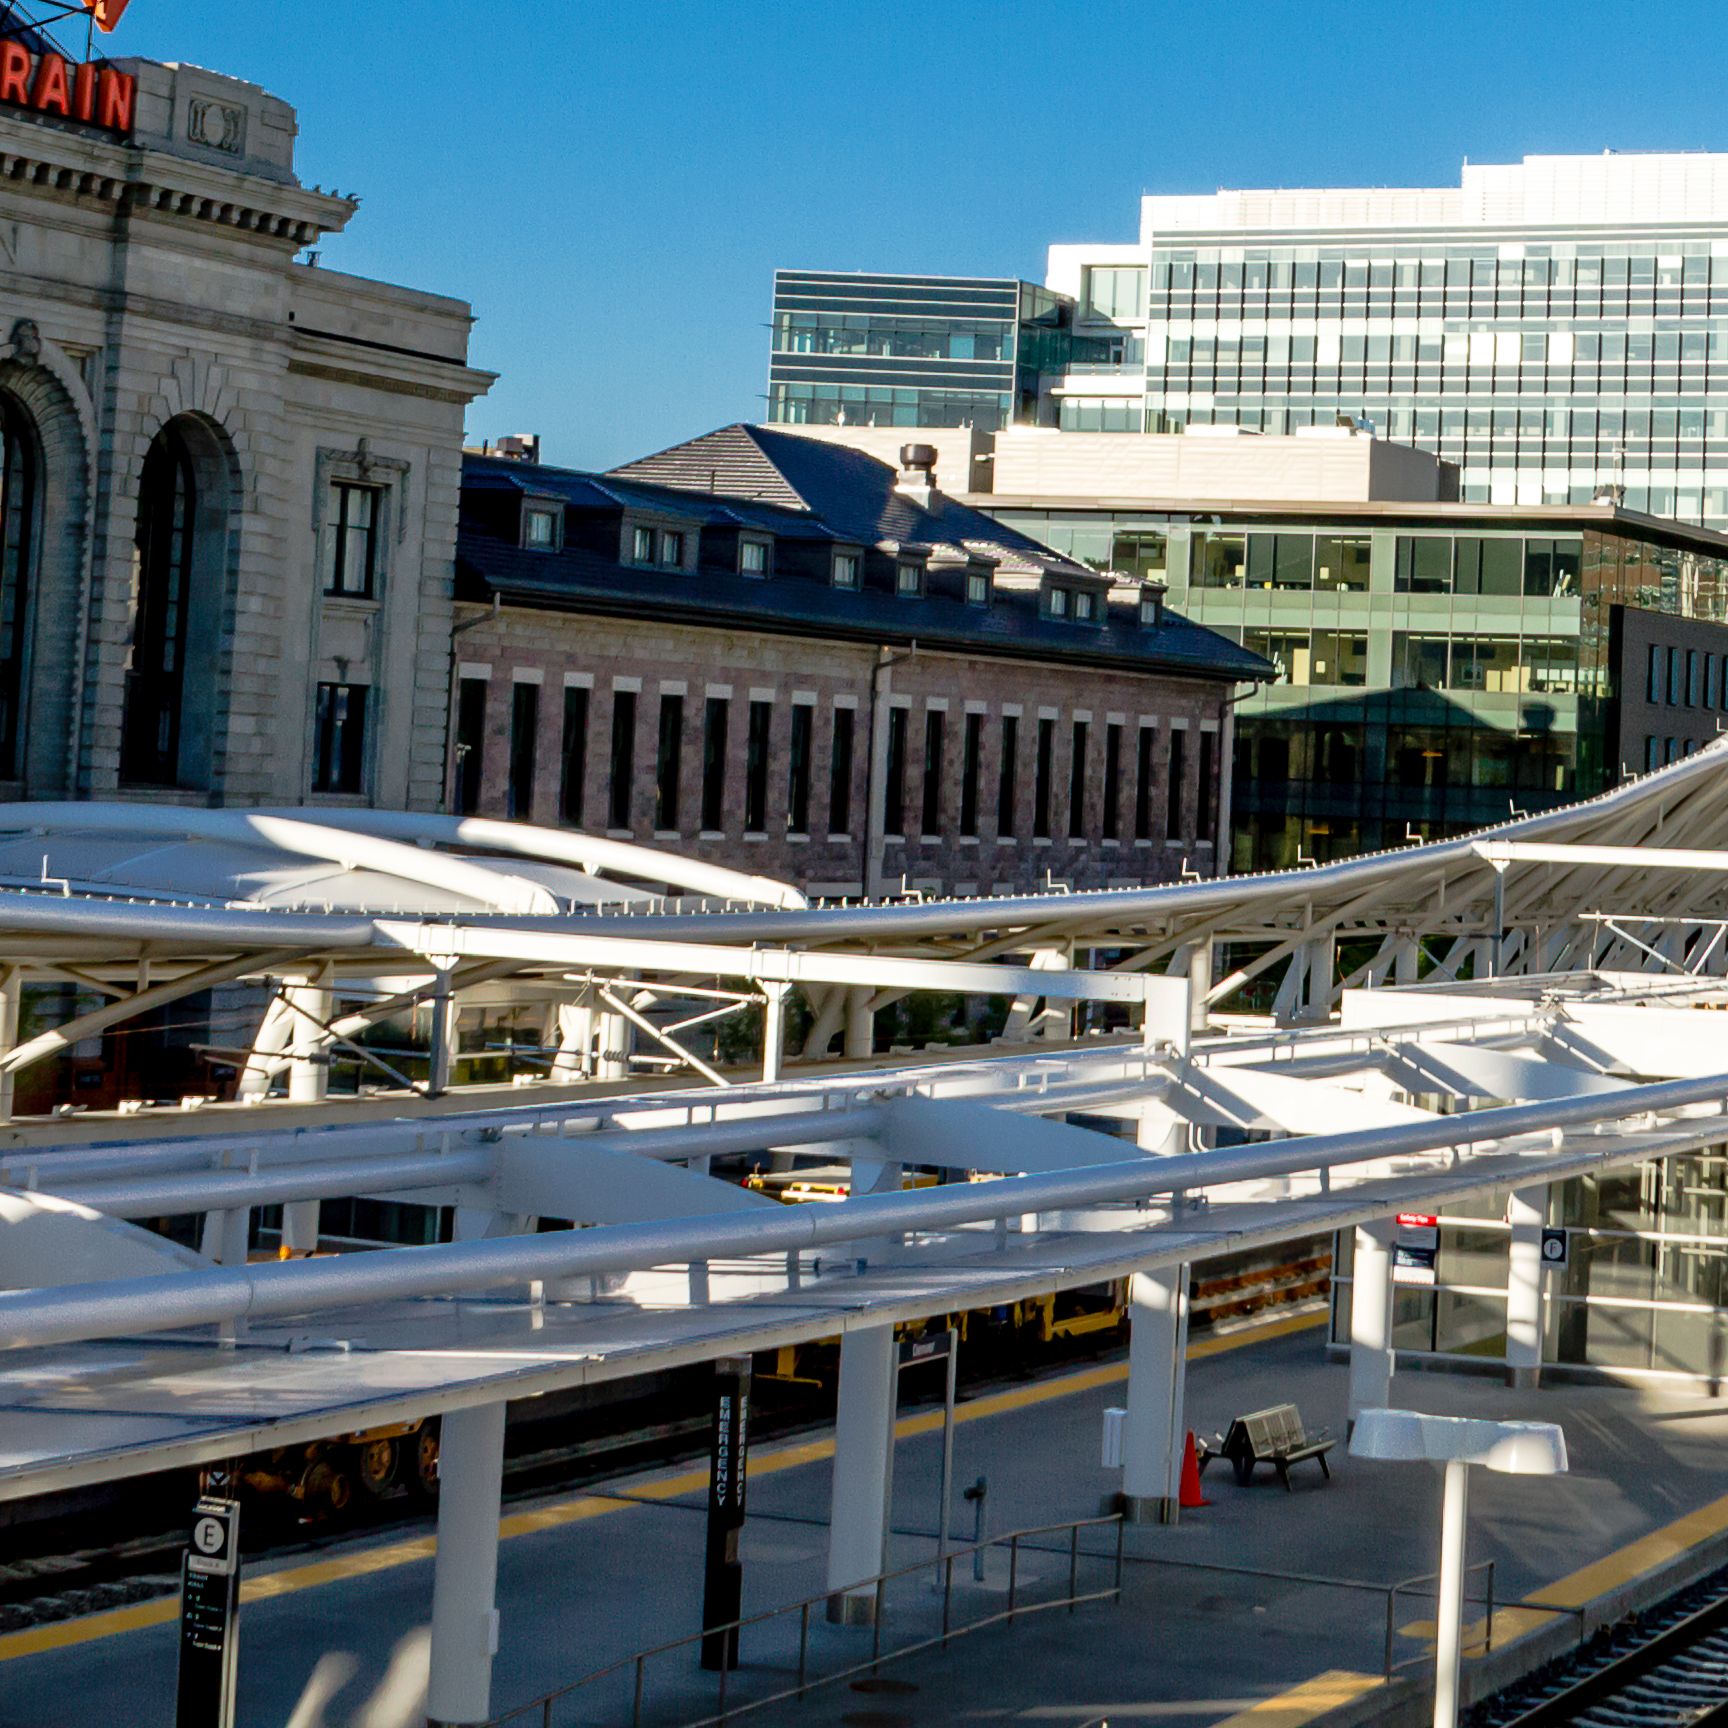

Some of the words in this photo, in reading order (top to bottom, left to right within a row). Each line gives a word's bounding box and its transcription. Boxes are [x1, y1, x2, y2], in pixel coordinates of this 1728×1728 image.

[717, 1396, 731, 1506] EMERGENCY
[737, 1396, 748, 1507] EMERGENCY
[204, 1524, 216, 1548] E
